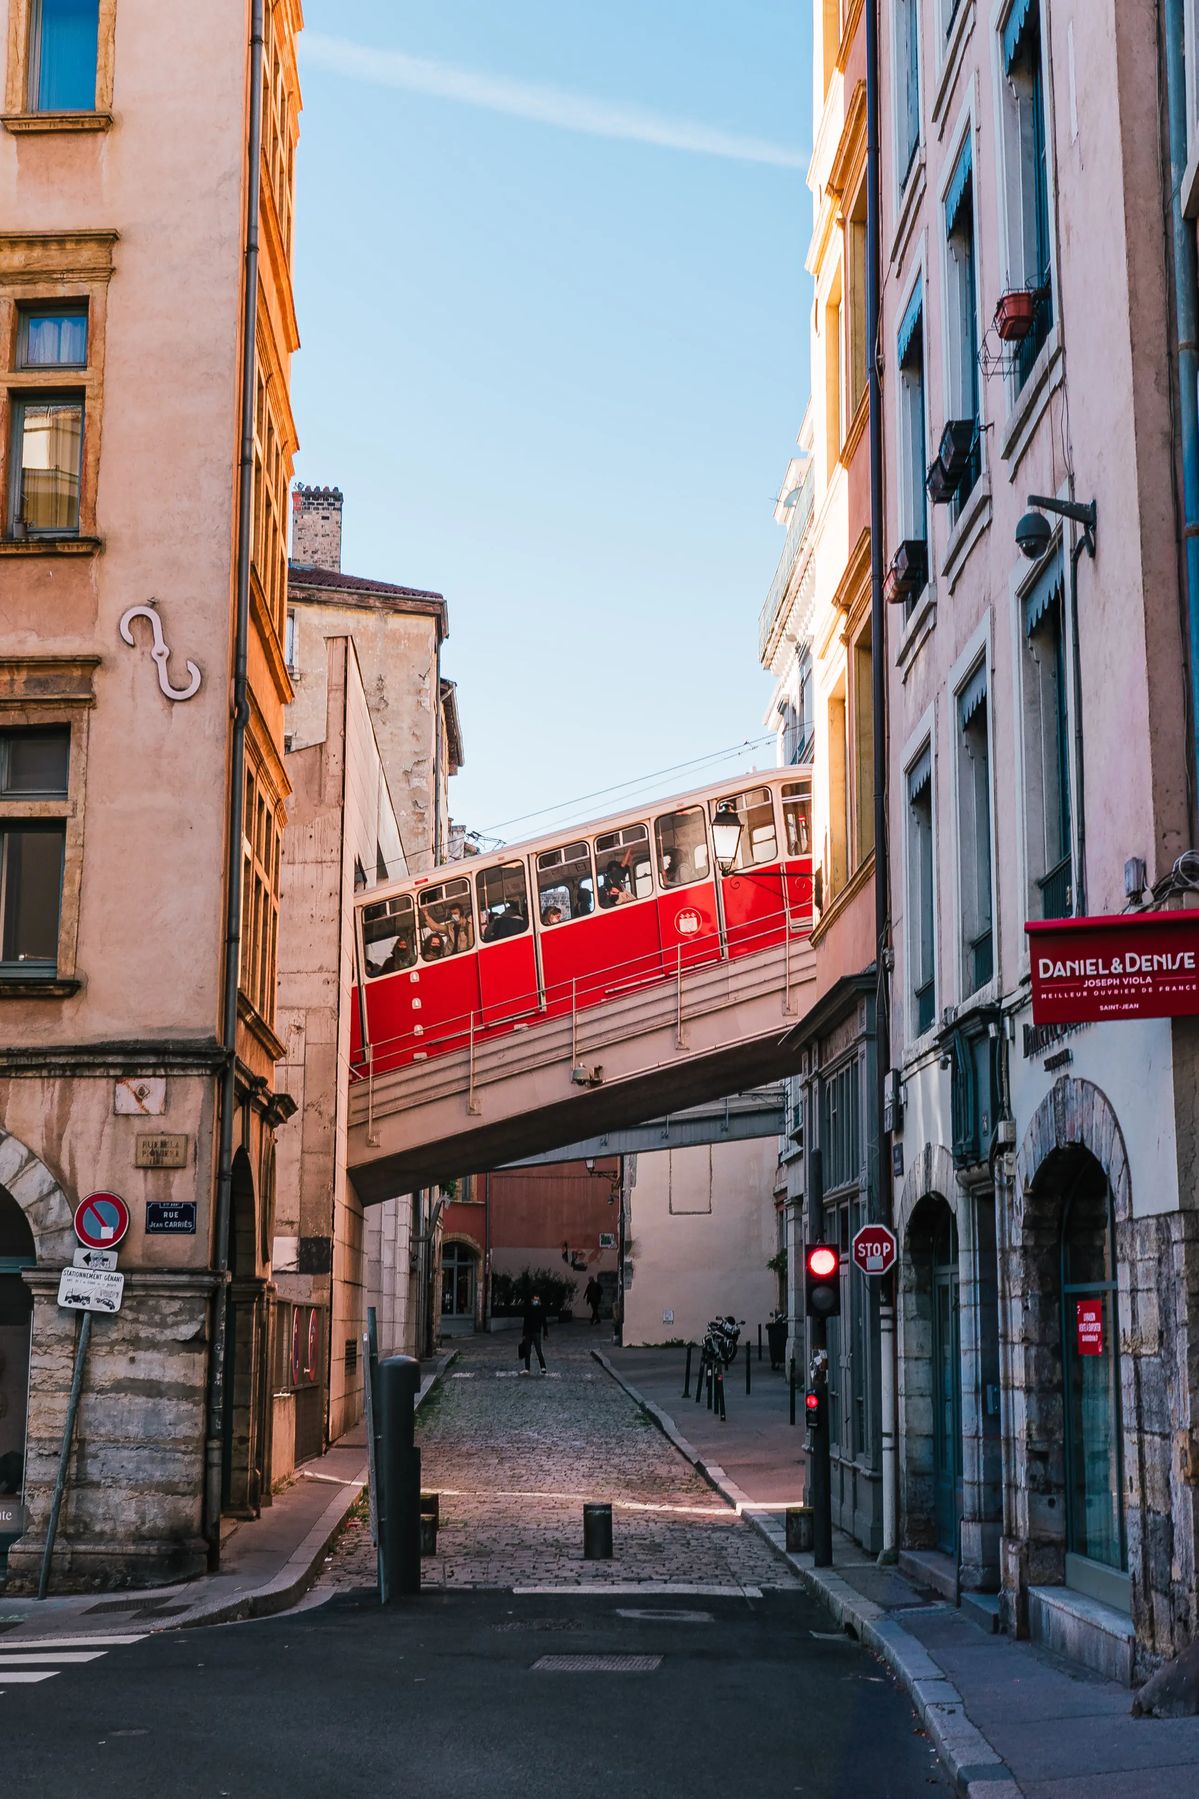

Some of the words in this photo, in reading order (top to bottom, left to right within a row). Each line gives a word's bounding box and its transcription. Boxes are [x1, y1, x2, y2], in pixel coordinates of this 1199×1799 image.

[1083, 978, 1120, 988] JOSEPH
[1122, 976, 1153, 985] VIOLA
[1041, 990, 1088, 999] MEILLEUR
[1093, 988, 1136, 997] OUVRIER
[1141, 986, 1153, 994] DE
[1159, 984, 1197, 993] FRANCE
[1099, 1003, 1139, 1011] SAINT-JEAN
[163, 1211, 179, 1219] RUE
[858, 1242, 891, 1257] STOP
[63, 1270, 102, 1280] STATIONNEMENT
